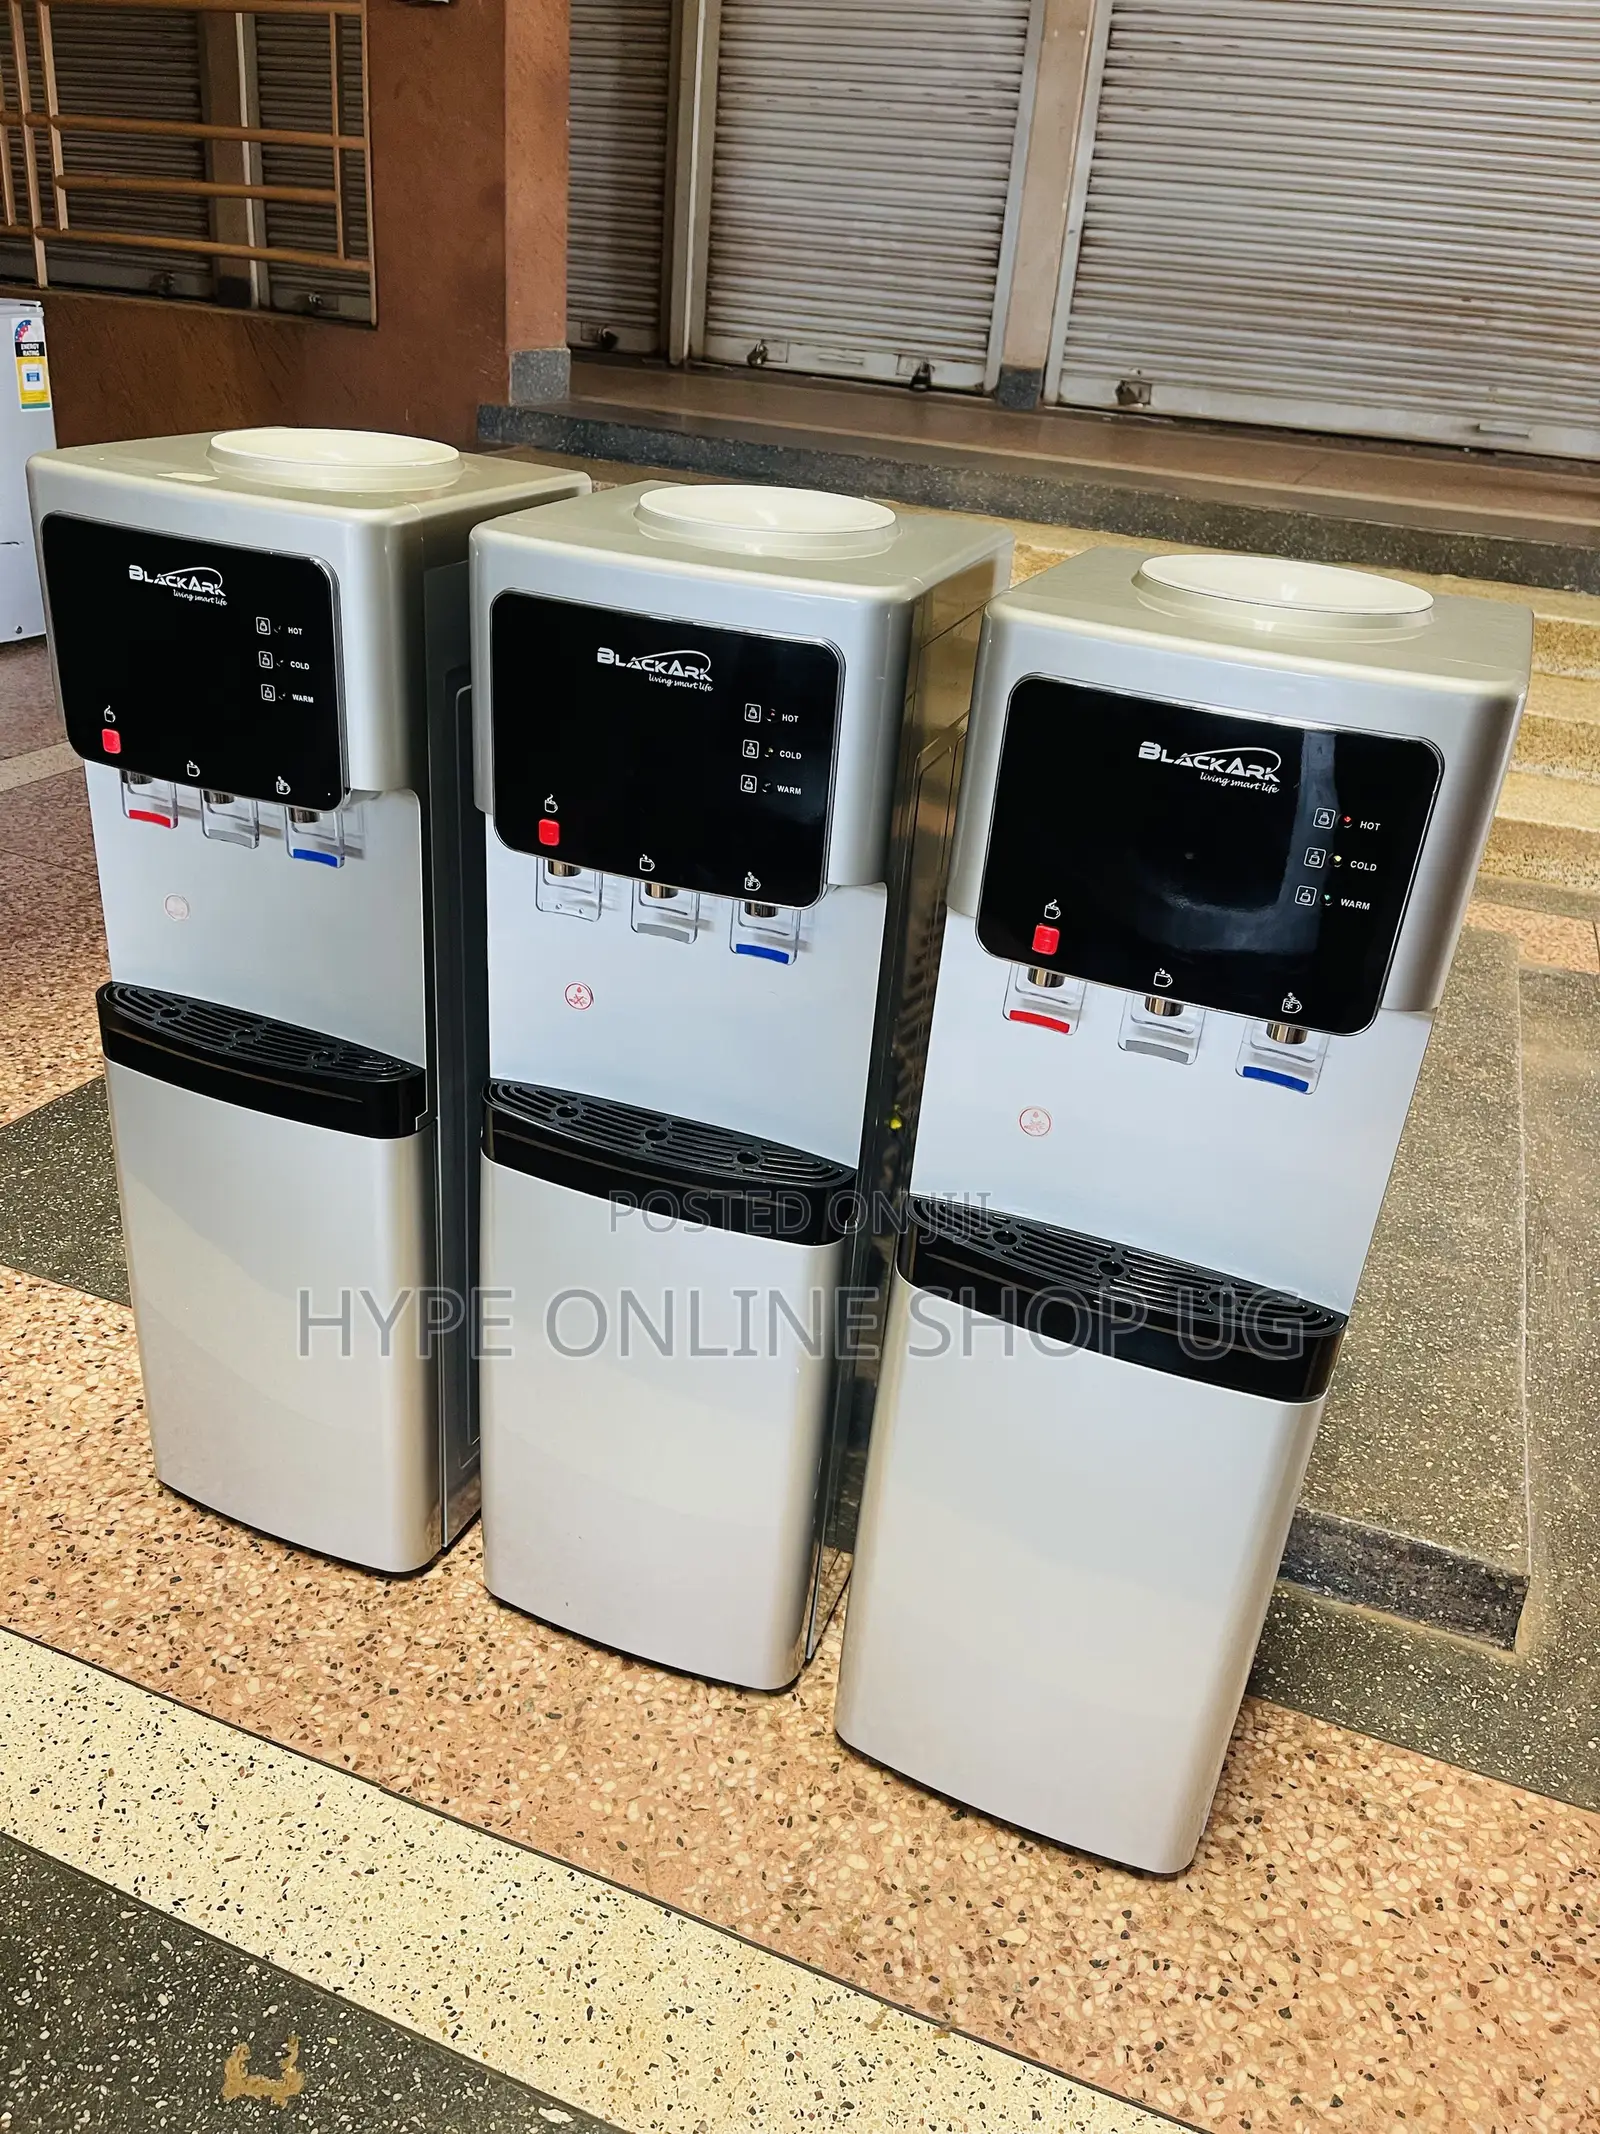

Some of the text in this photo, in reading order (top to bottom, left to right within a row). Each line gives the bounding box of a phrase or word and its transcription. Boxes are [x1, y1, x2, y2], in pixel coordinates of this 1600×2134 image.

[172, 588, 228, 606] living smart life
[287, 626, 303, 636] HOT
[290, 660, 310, 671] COLD
[648, 673, 714, 693] living smart life
[292, 693, 314, 704] WARM
[781, 713, 799, 723] HOT
[779, 749, 802, 760] COLD
[1199, 771, 1280, 794] living smart life
[776, 784, 802, 796] WARM
[1359, 820, 1381, 831] HOT
[1349, 860, 1377, 872] COLD
[1340, 898, 1371, 910] WARM
